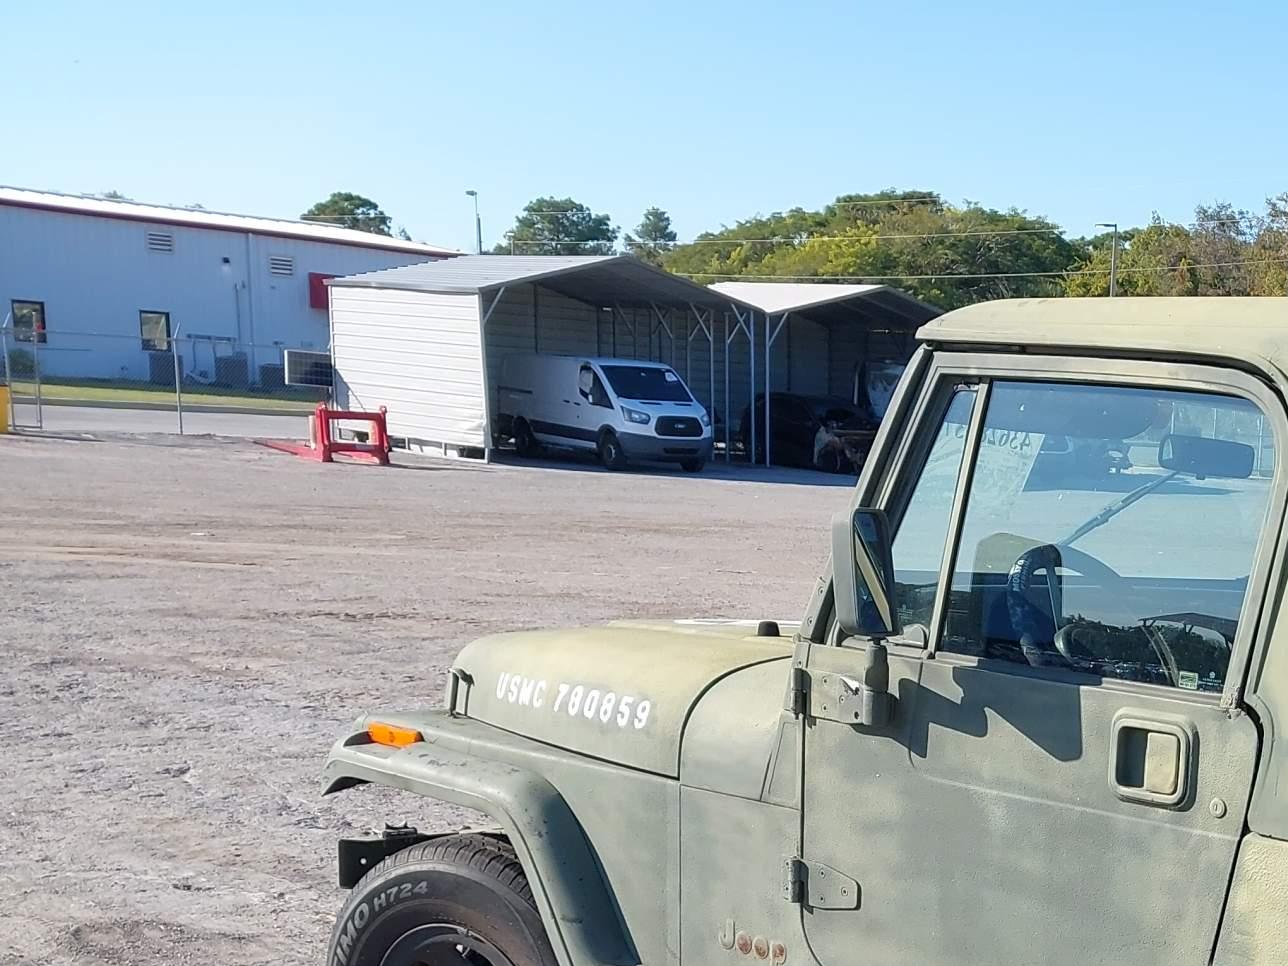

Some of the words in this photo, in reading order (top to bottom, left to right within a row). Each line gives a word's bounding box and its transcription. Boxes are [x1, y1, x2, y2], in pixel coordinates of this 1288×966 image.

[495, 672, 547, 708] USMC
[553, 682, 652, 729] 780859
[372, 880, 429, 911] H724
